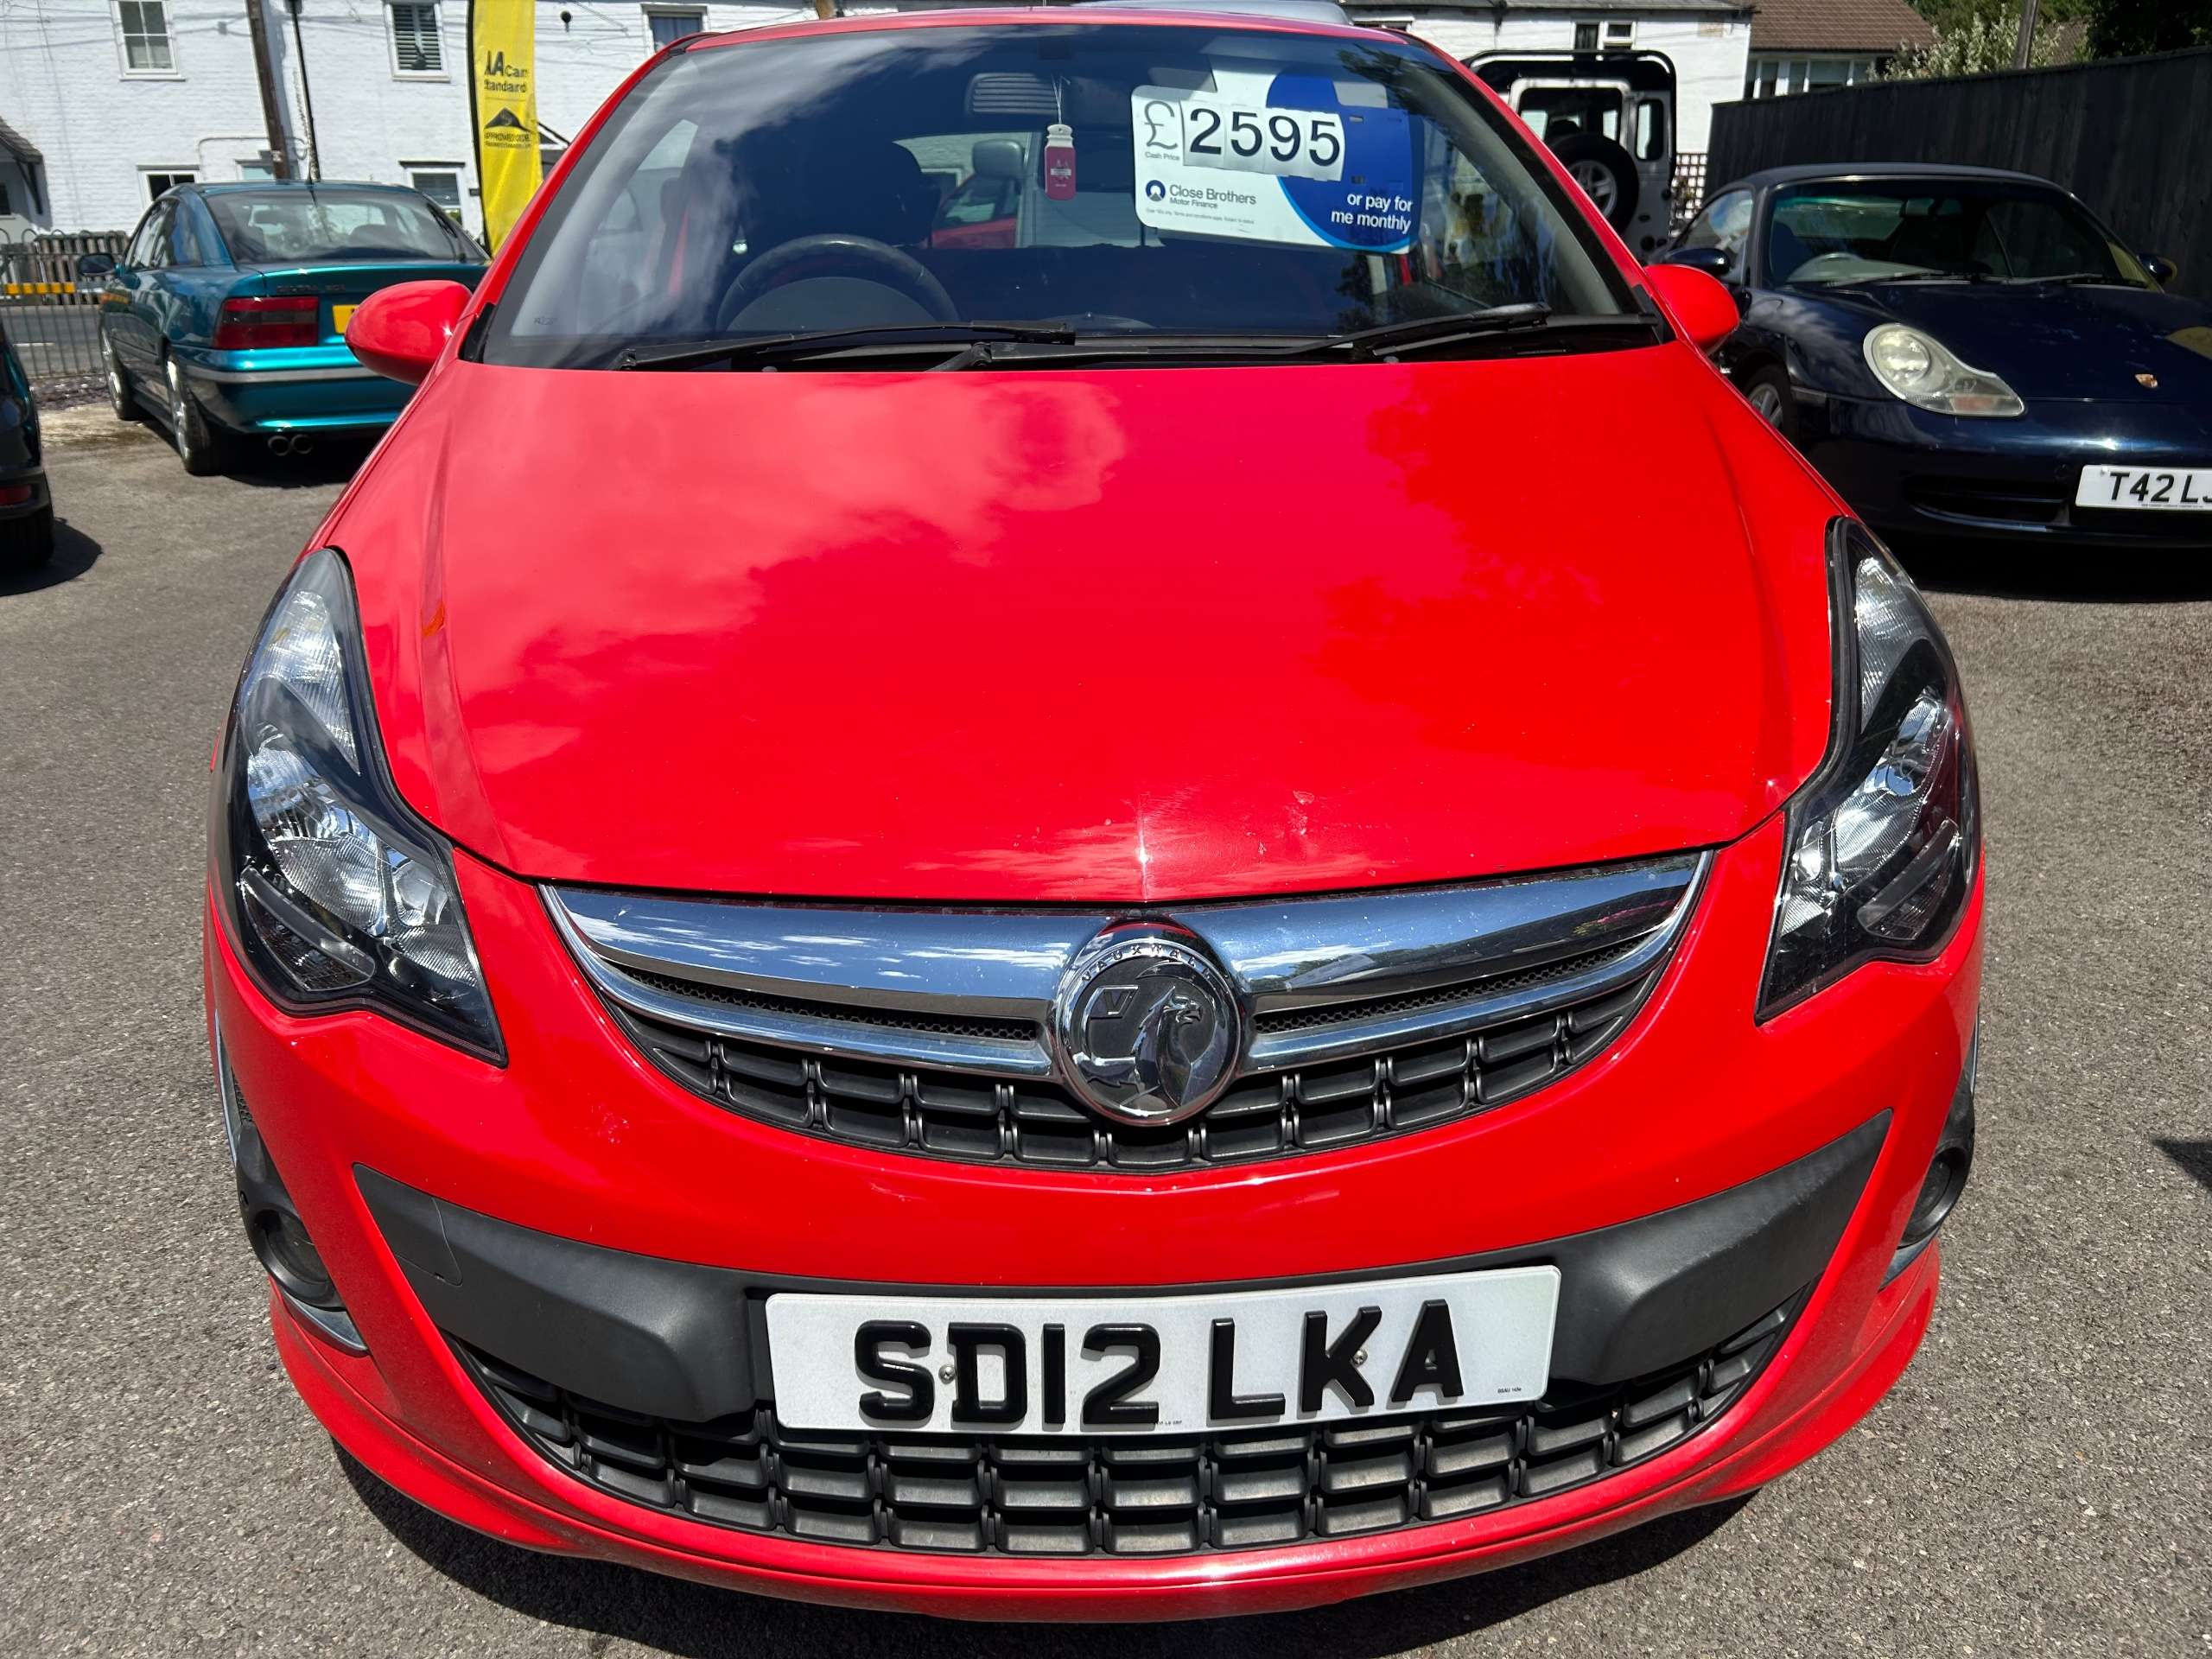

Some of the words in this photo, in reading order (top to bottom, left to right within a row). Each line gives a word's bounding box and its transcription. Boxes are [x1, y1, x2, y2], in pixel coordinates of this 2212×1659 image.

[1163, 153, 1180, 162] Price
[1169, 184, 1204, 200] Close
[1206, 188, 1256, 205] Brothers
[1192, 200, 1218, 209] Finance
[1347, 193, 1361, 206] or
[1366, 195, 1391, 213] pay
[1394, 196, 1413, 212] for
[1332, 210, 1353, 225] me
[1357, 213, 1412, 234] monthly
[2110, 472, 2175, 503] T42
[1209, 1298, 1465, 1419] LKA
